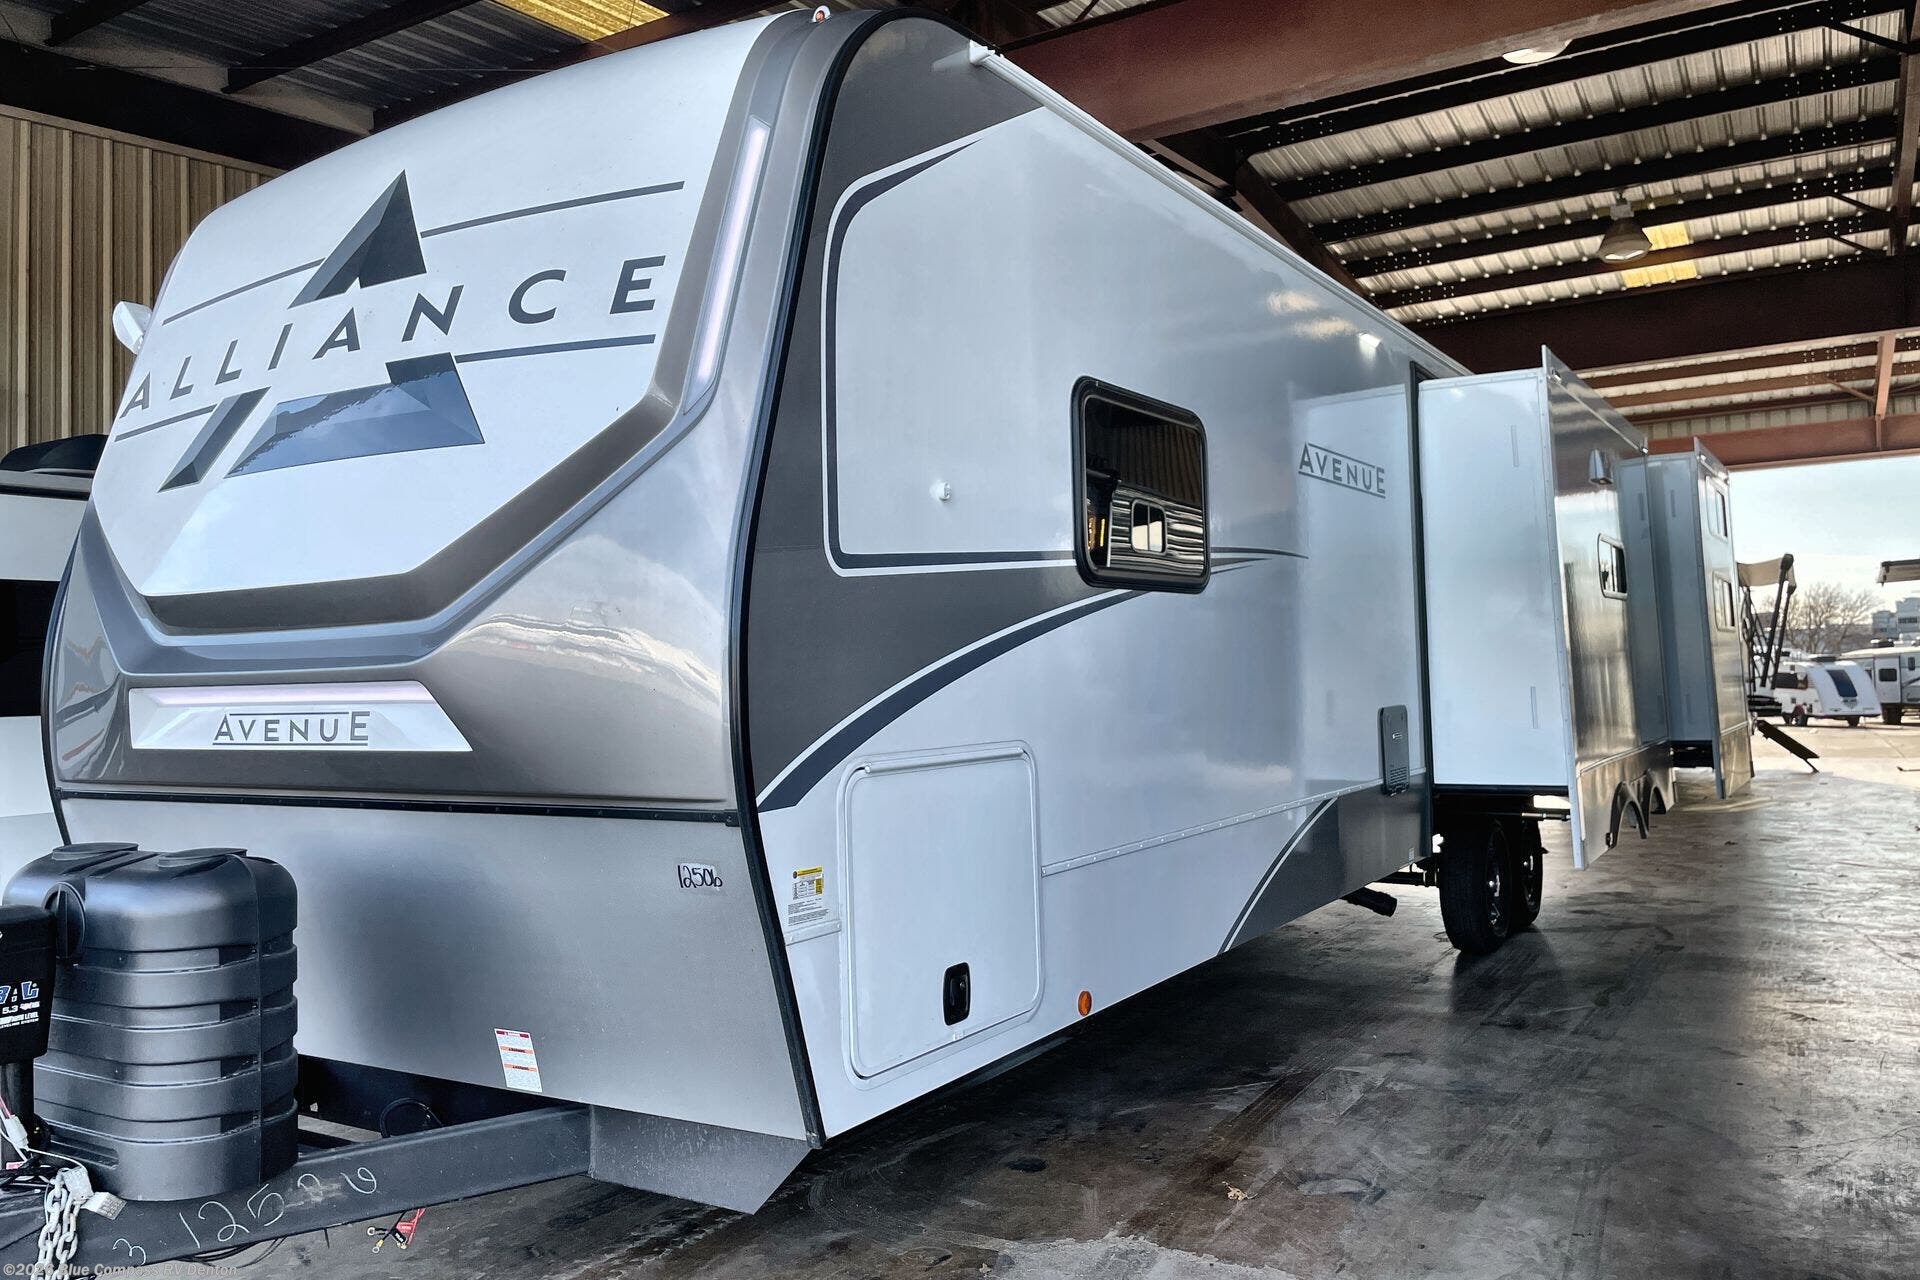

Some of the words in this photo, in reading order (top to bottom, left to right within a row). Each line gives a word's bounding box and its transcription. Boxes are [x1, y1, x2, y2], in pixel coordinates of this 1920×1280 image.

[121, 255, 666, 418] ALLIANCE
[1299, 442, 1386, 495] AVENUE
[213, 710, 371, 742] AVENUE
[677, 864, 723, 889] 12506
